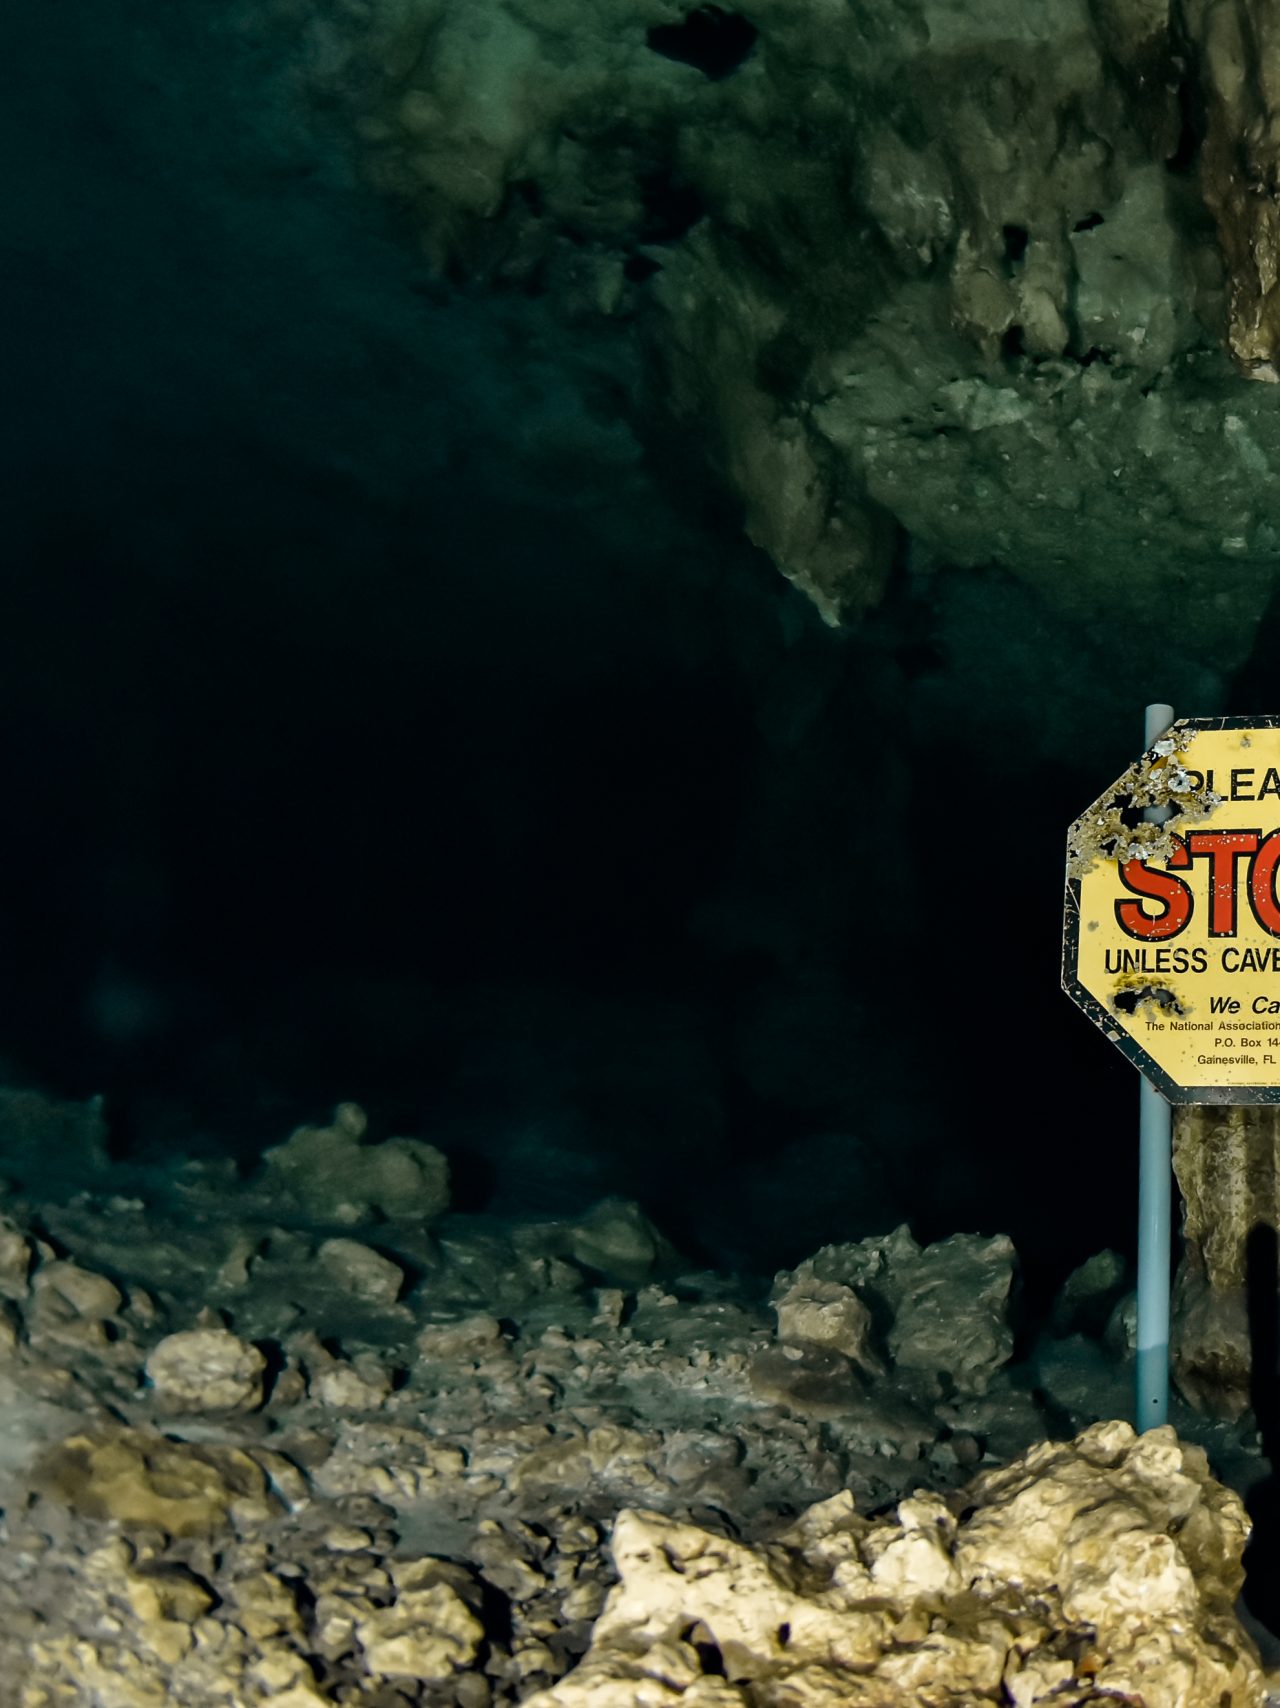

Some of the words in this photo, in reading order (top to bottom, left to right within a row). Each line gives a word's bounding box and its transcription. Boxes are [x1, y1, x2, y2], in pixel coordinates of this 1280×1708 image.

[1104, 948, 1208, 974] UNLESS
[1209, 996, 1241, 1015] We
[1145, 1021, 1165, 1031] The
[1169, 1021, 1214, 1031] National
[1214, 1037, 1236, 1048] P.O.
[1240, 1037, 1262, 1048] Box
[1197, 1054, 1258, 1066] Gainesville,
[1263, 1054, 1277, 1064] FL
